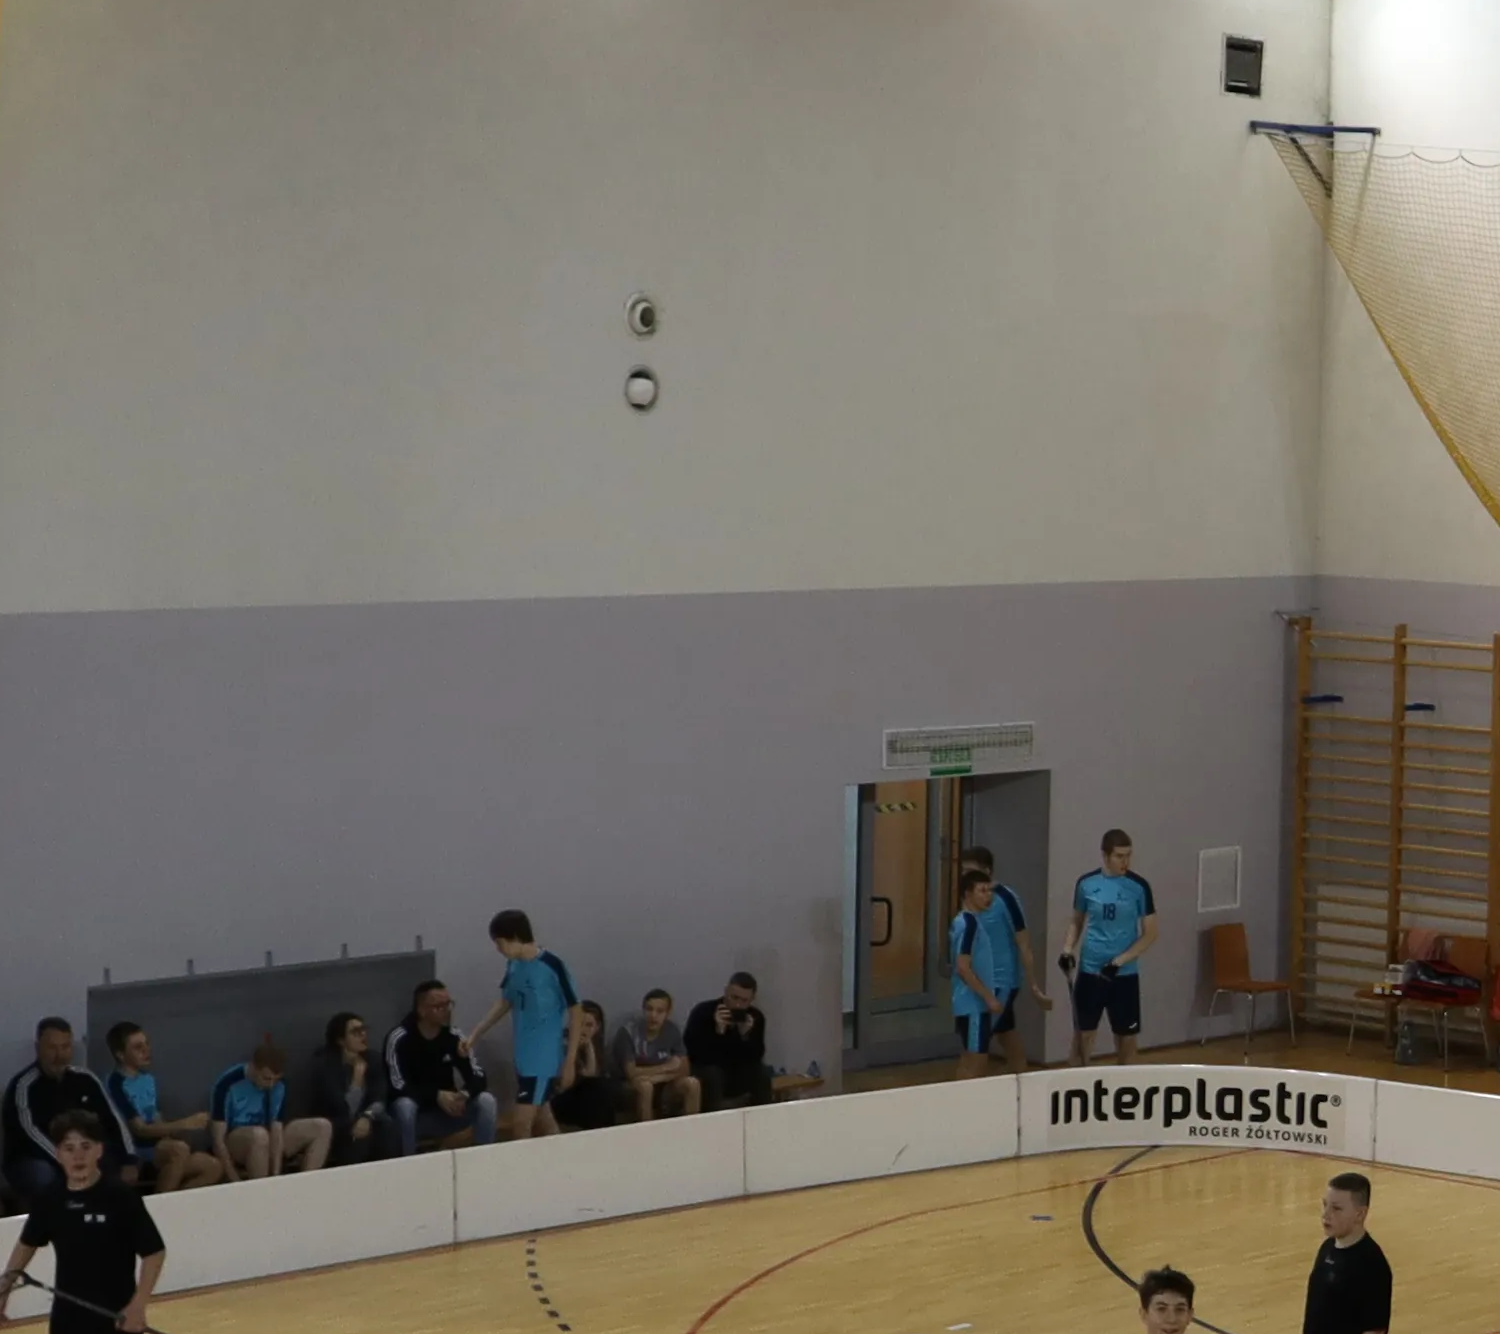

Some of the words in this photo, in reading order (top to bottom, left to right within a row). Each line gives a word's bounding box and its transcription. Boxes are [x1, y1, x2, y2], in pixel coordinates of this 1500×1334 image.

[1102, 902, 1116, 921] 18
[1189, 1125, 1240, 1139] ROGER
[1246, 1124, 1328, 1146] ŻÓŁTOWSKI
